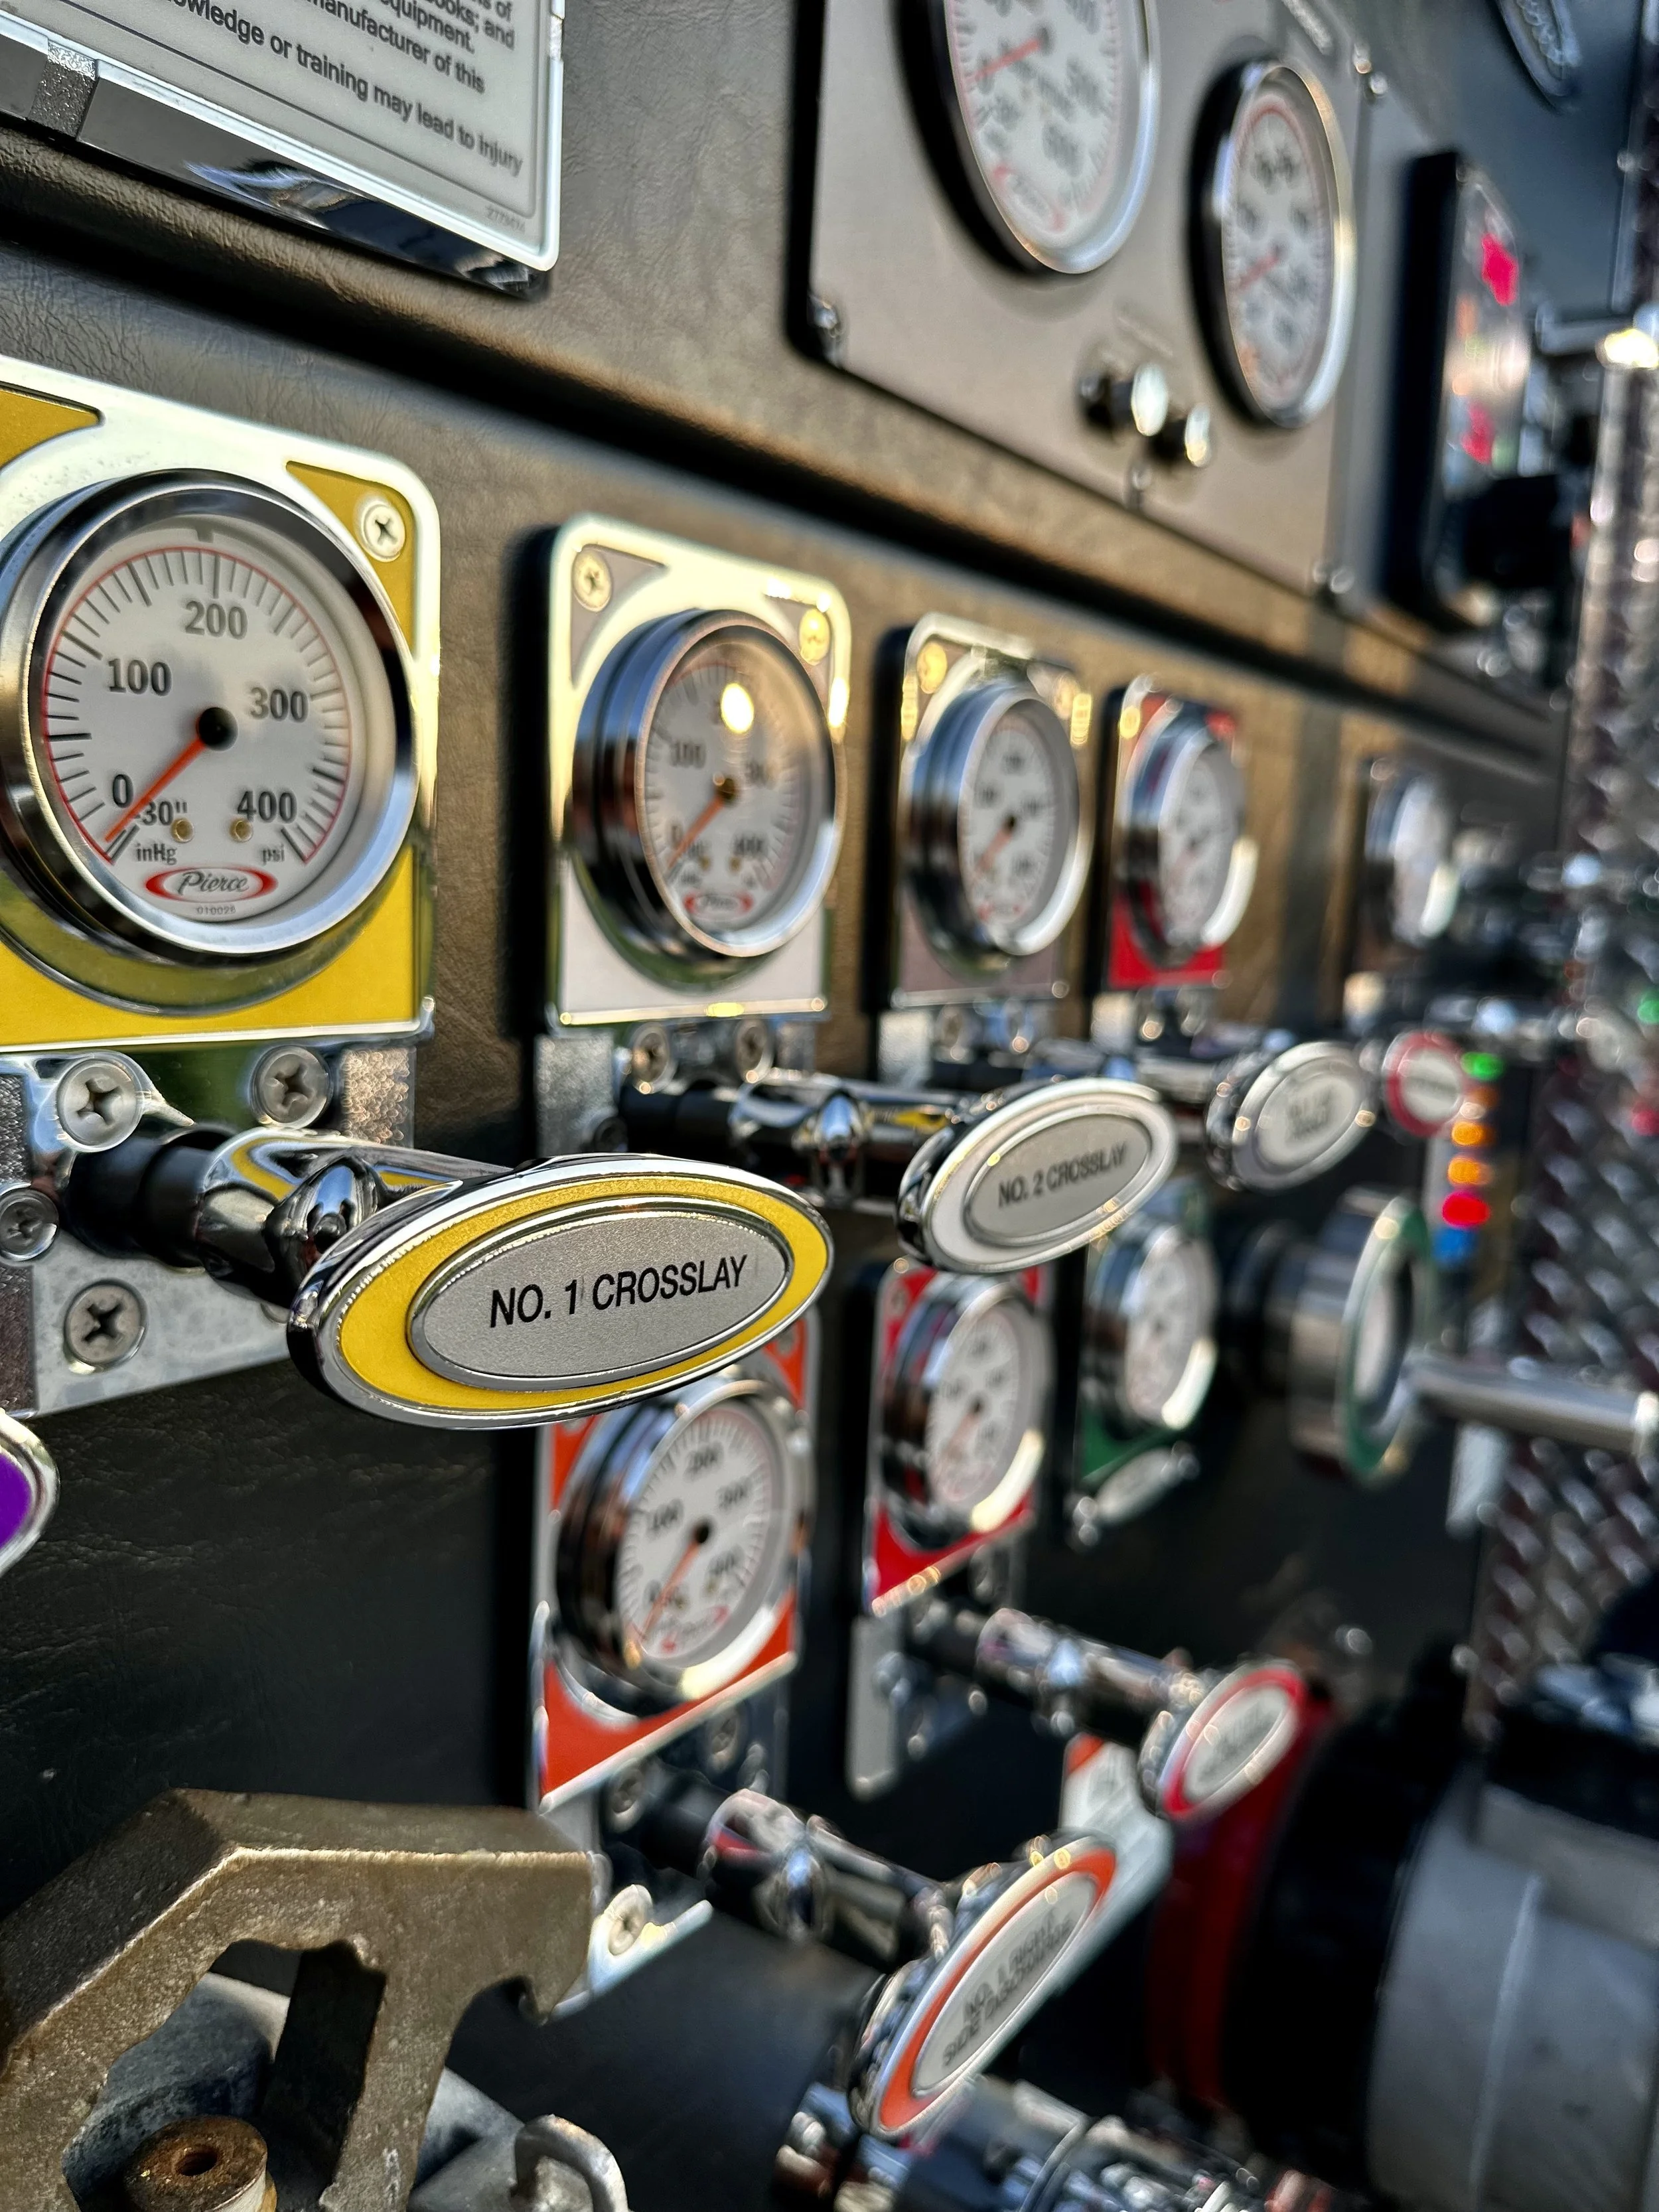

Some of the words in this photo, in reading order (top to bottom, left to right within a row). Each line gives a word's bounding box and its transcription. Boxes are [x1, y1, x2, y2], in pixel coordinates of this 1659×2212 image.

[496, 1, 512, 22] of
[483, 19, 515, 51] and
[433, 53, 453, 76] of
[455, 61, 485, 94] this
[269, 35, 292, 58] or
[297, 43, 368, 102] training
[374, 85, 413, 123] may
[417, 102, 455, 141] lead
[457, 123, 476, 150] to
[478, 135, 523, 178] injury
[185, 601, 248, 639] 200
[108, 658, 172, 697] 100
[250, 688, 309, 723] 300
[112, 774, 133, 808] 0
[237, 790, 297, 824] 400
[135, 843, 177, 865] inHg
[261, 844, 285, 865] psi
[177, 871, 250, 895] Pierce
[997, 1175, 1029, 1208] NO.
[1033, 1169, 1045, 1196] 2
[1046, 1140, 1127, 1192] CROSSLAY
[490, 1284, 551, 1328] NO.
[565, 1279, 578, 1315] 1
[592, 1254, 748, 1311] CROSSLAY
